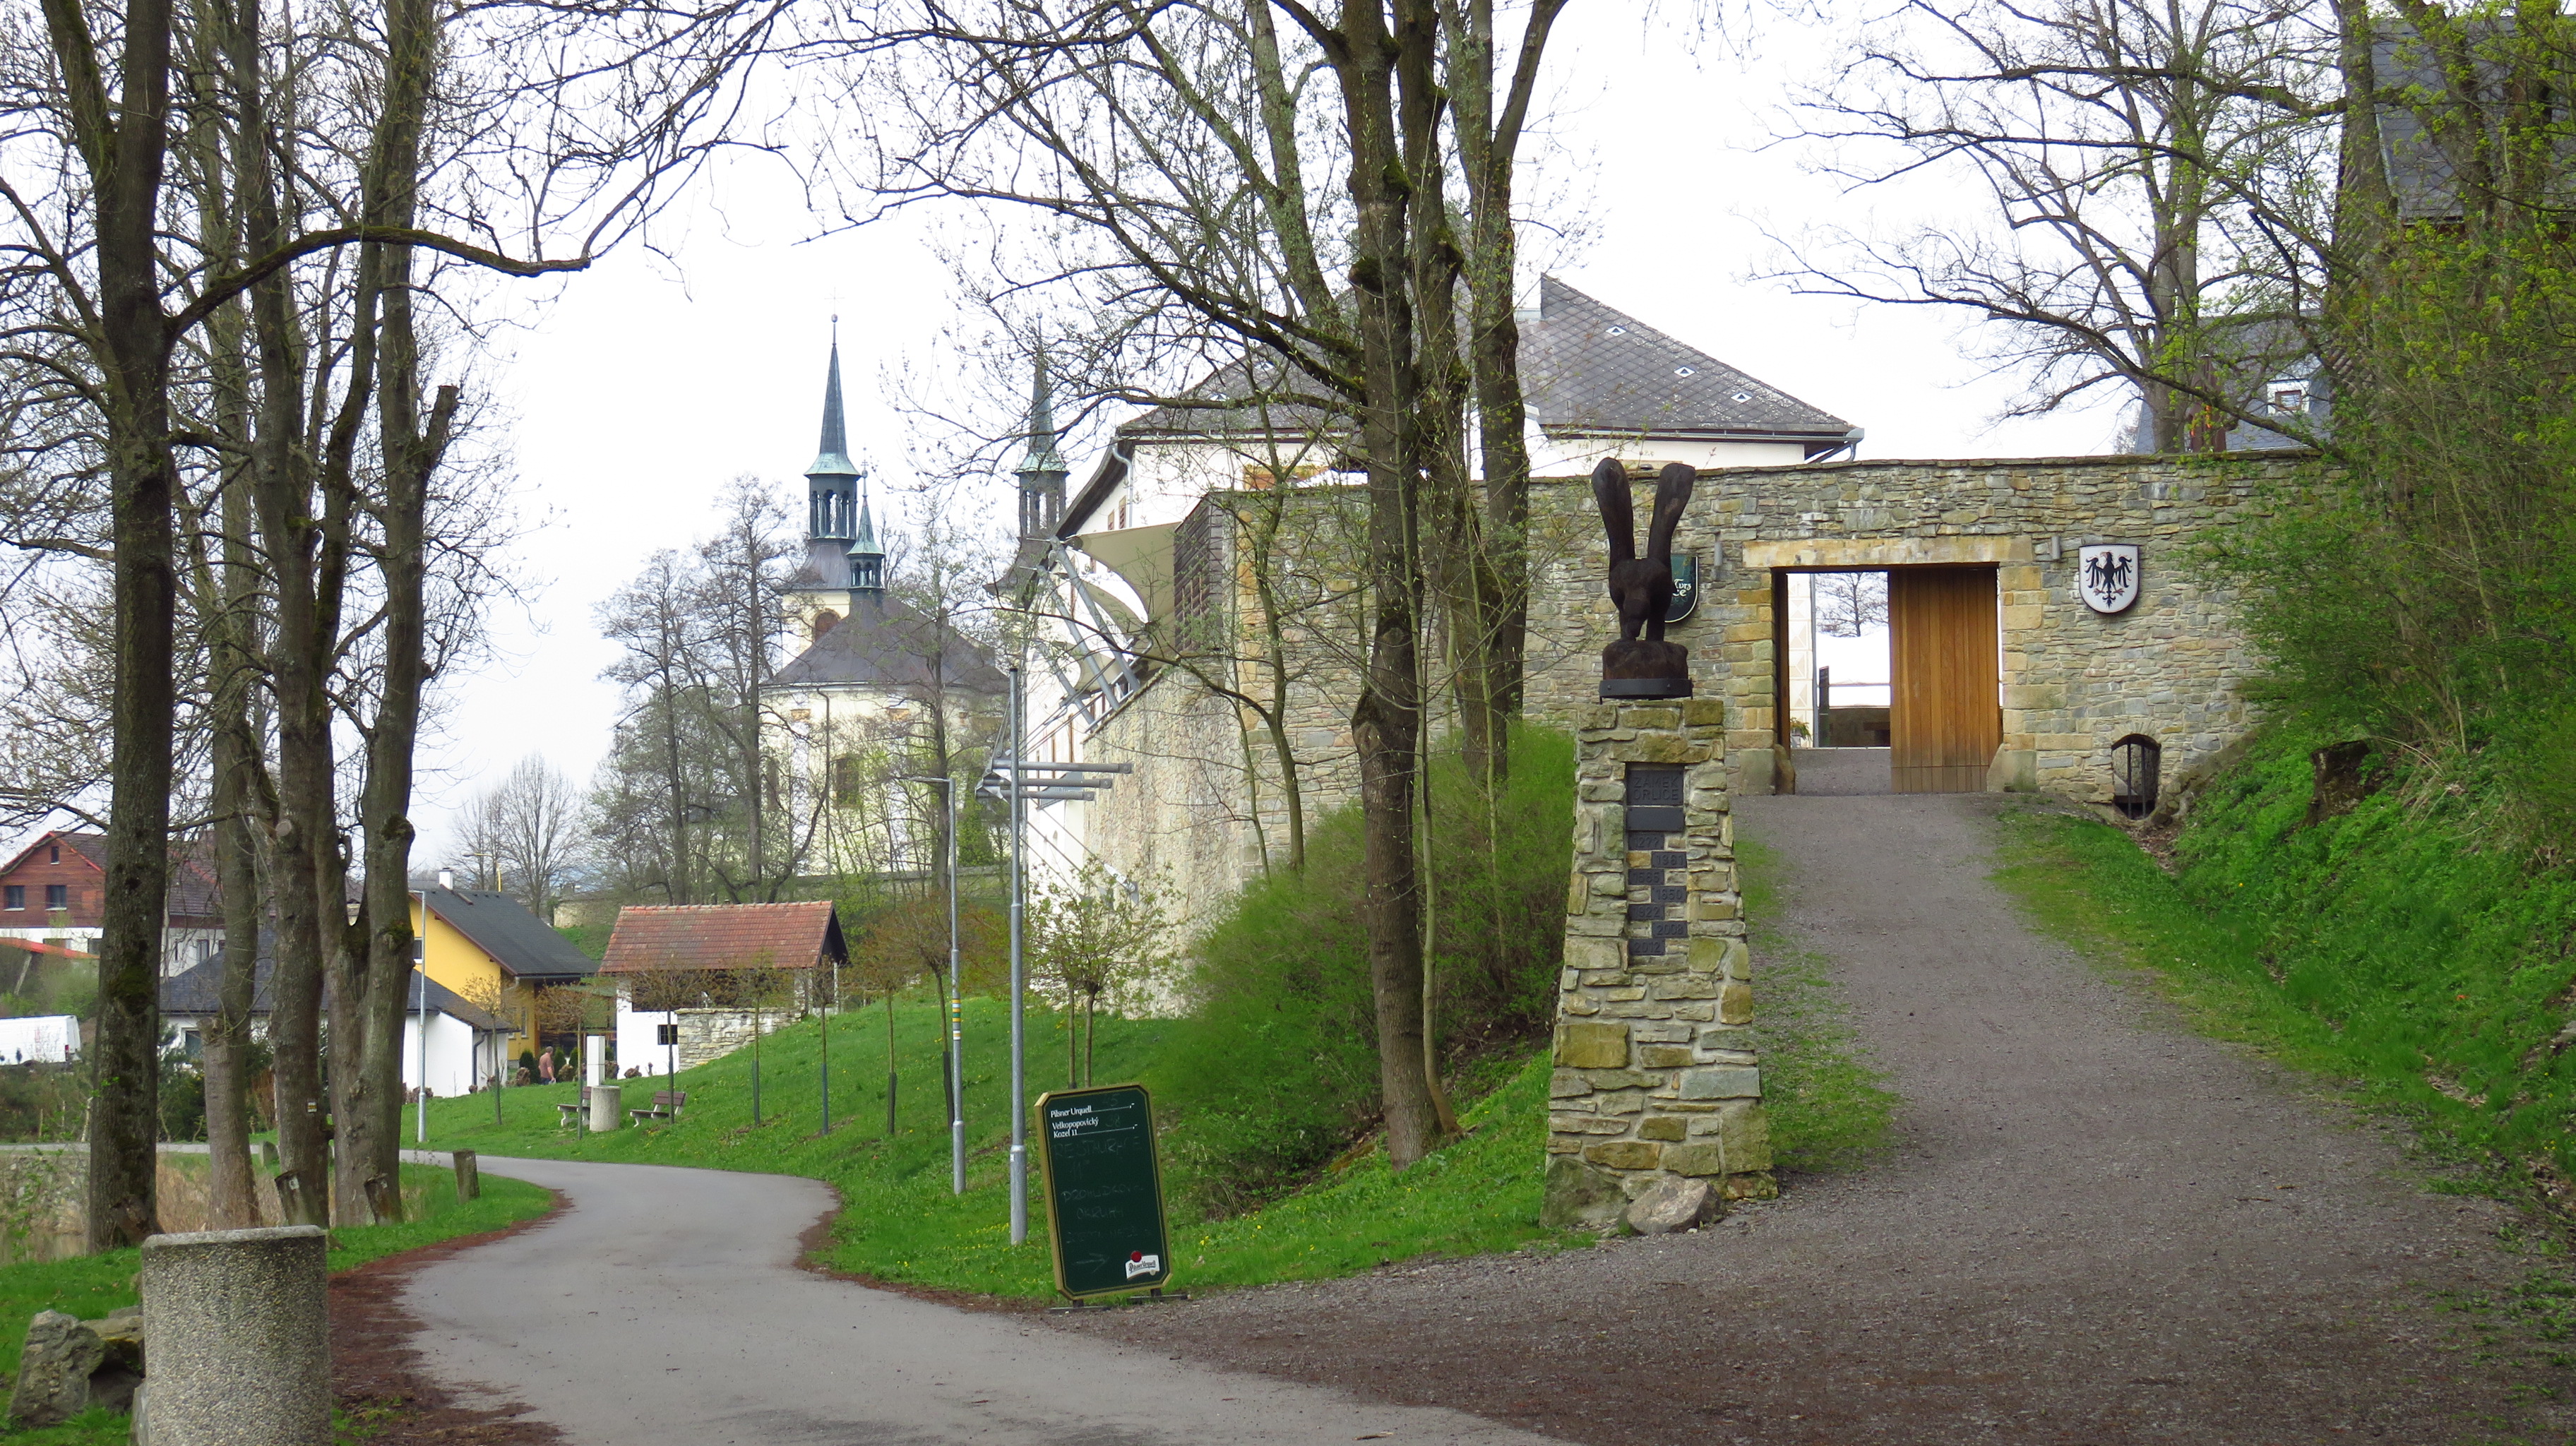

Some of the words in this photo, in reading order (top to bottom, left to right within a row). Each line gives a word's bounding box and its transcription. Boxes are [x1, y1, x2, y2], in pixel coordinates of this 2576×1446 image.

[1633, 789, 1679, 800] ORLICE
[1633, 906, 1660, 917] 1922
[1657, 924, 1683, 935] 2008
[1634, 942, 1660, 952] 2012
[1051, 1109, 1071, 1118] Pilsner
[1071, 1105, 1092, 1116] Urquell
[1052, 1117, 1099, 1130] Velkopopovický
[1054, 1130, 1071, 1138] Kozel
